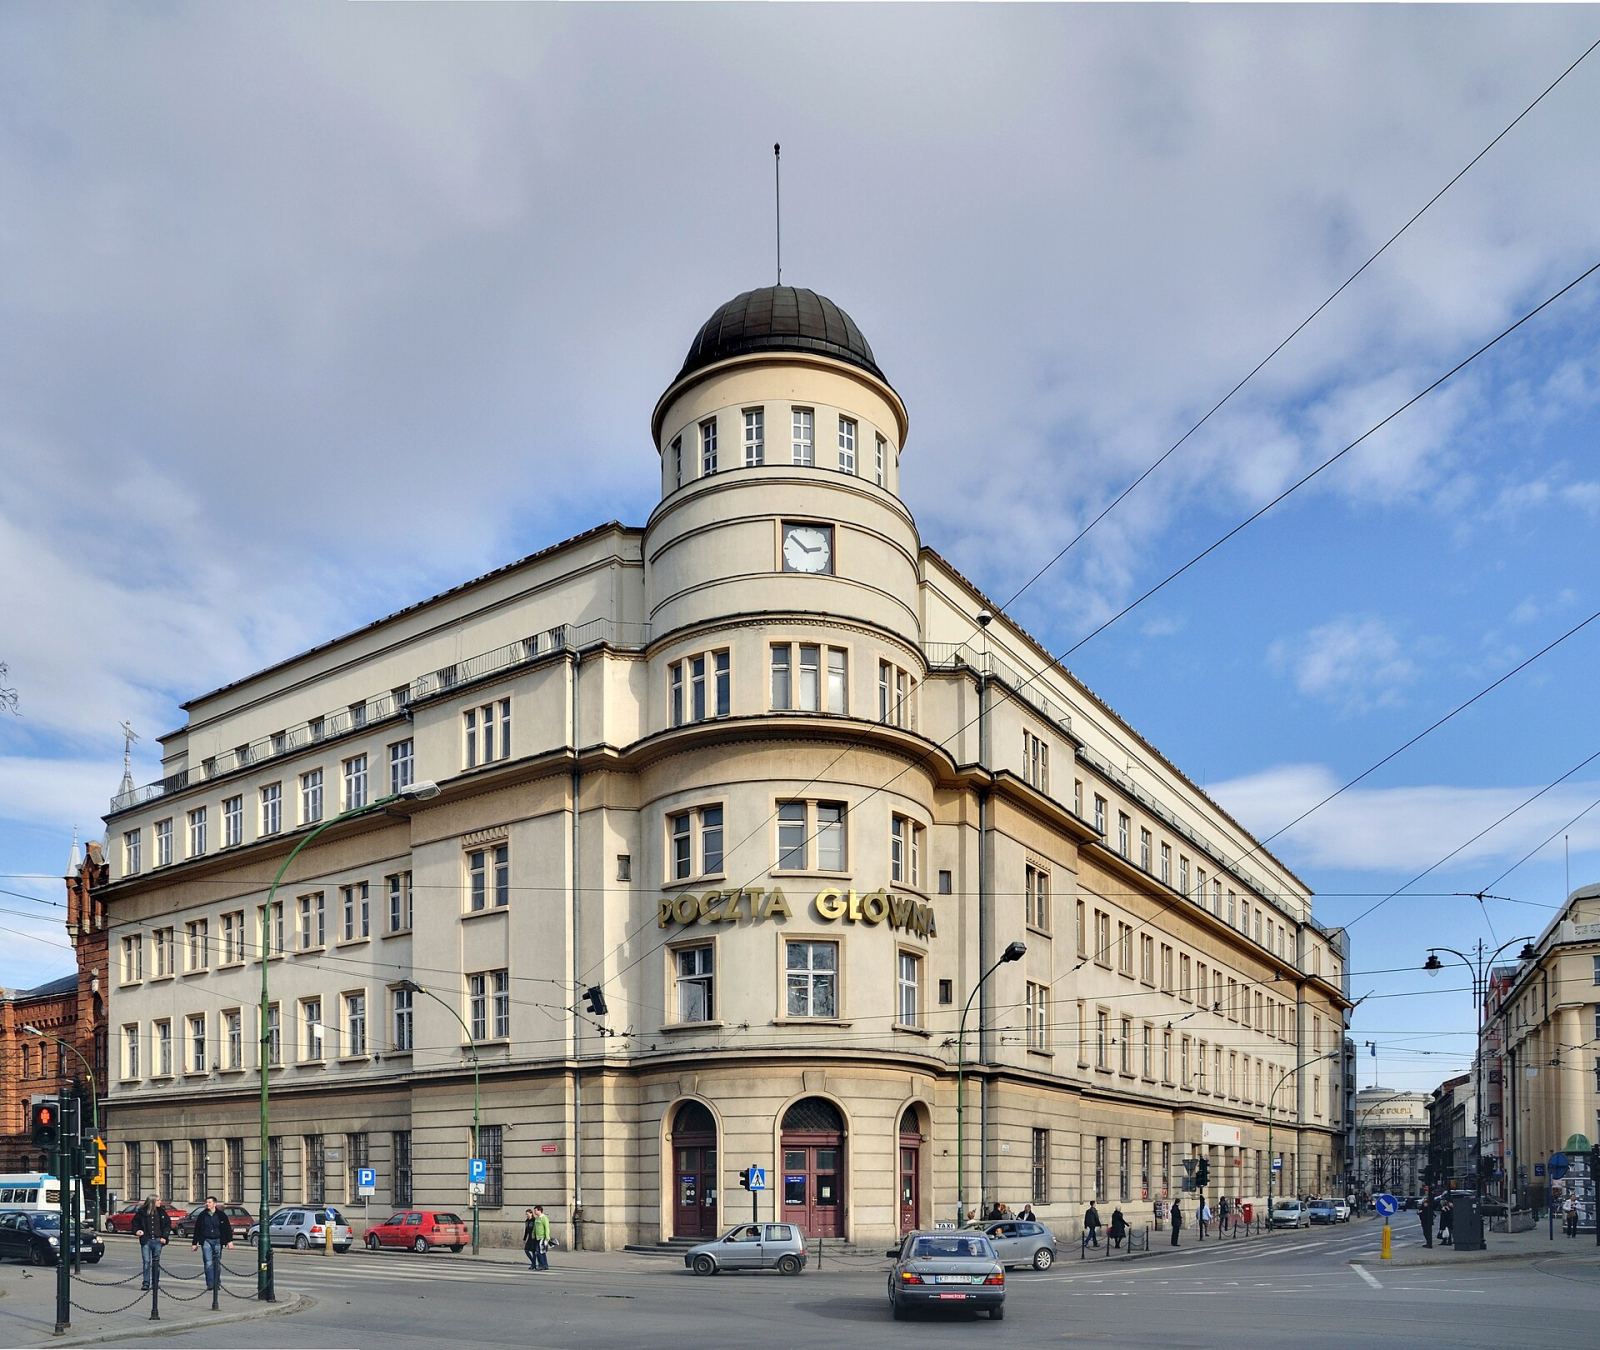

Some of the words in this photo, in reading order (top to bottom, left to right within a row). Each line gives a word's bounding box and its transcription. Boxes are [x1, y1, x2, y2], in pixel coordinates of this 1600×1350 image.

[658, 886, 792, 928] POCZTA
[815, 887, 937, 940] GŁÓWNA
[473, 1161, 483, 1176] P
[361, 1170, 372, 1184] P
